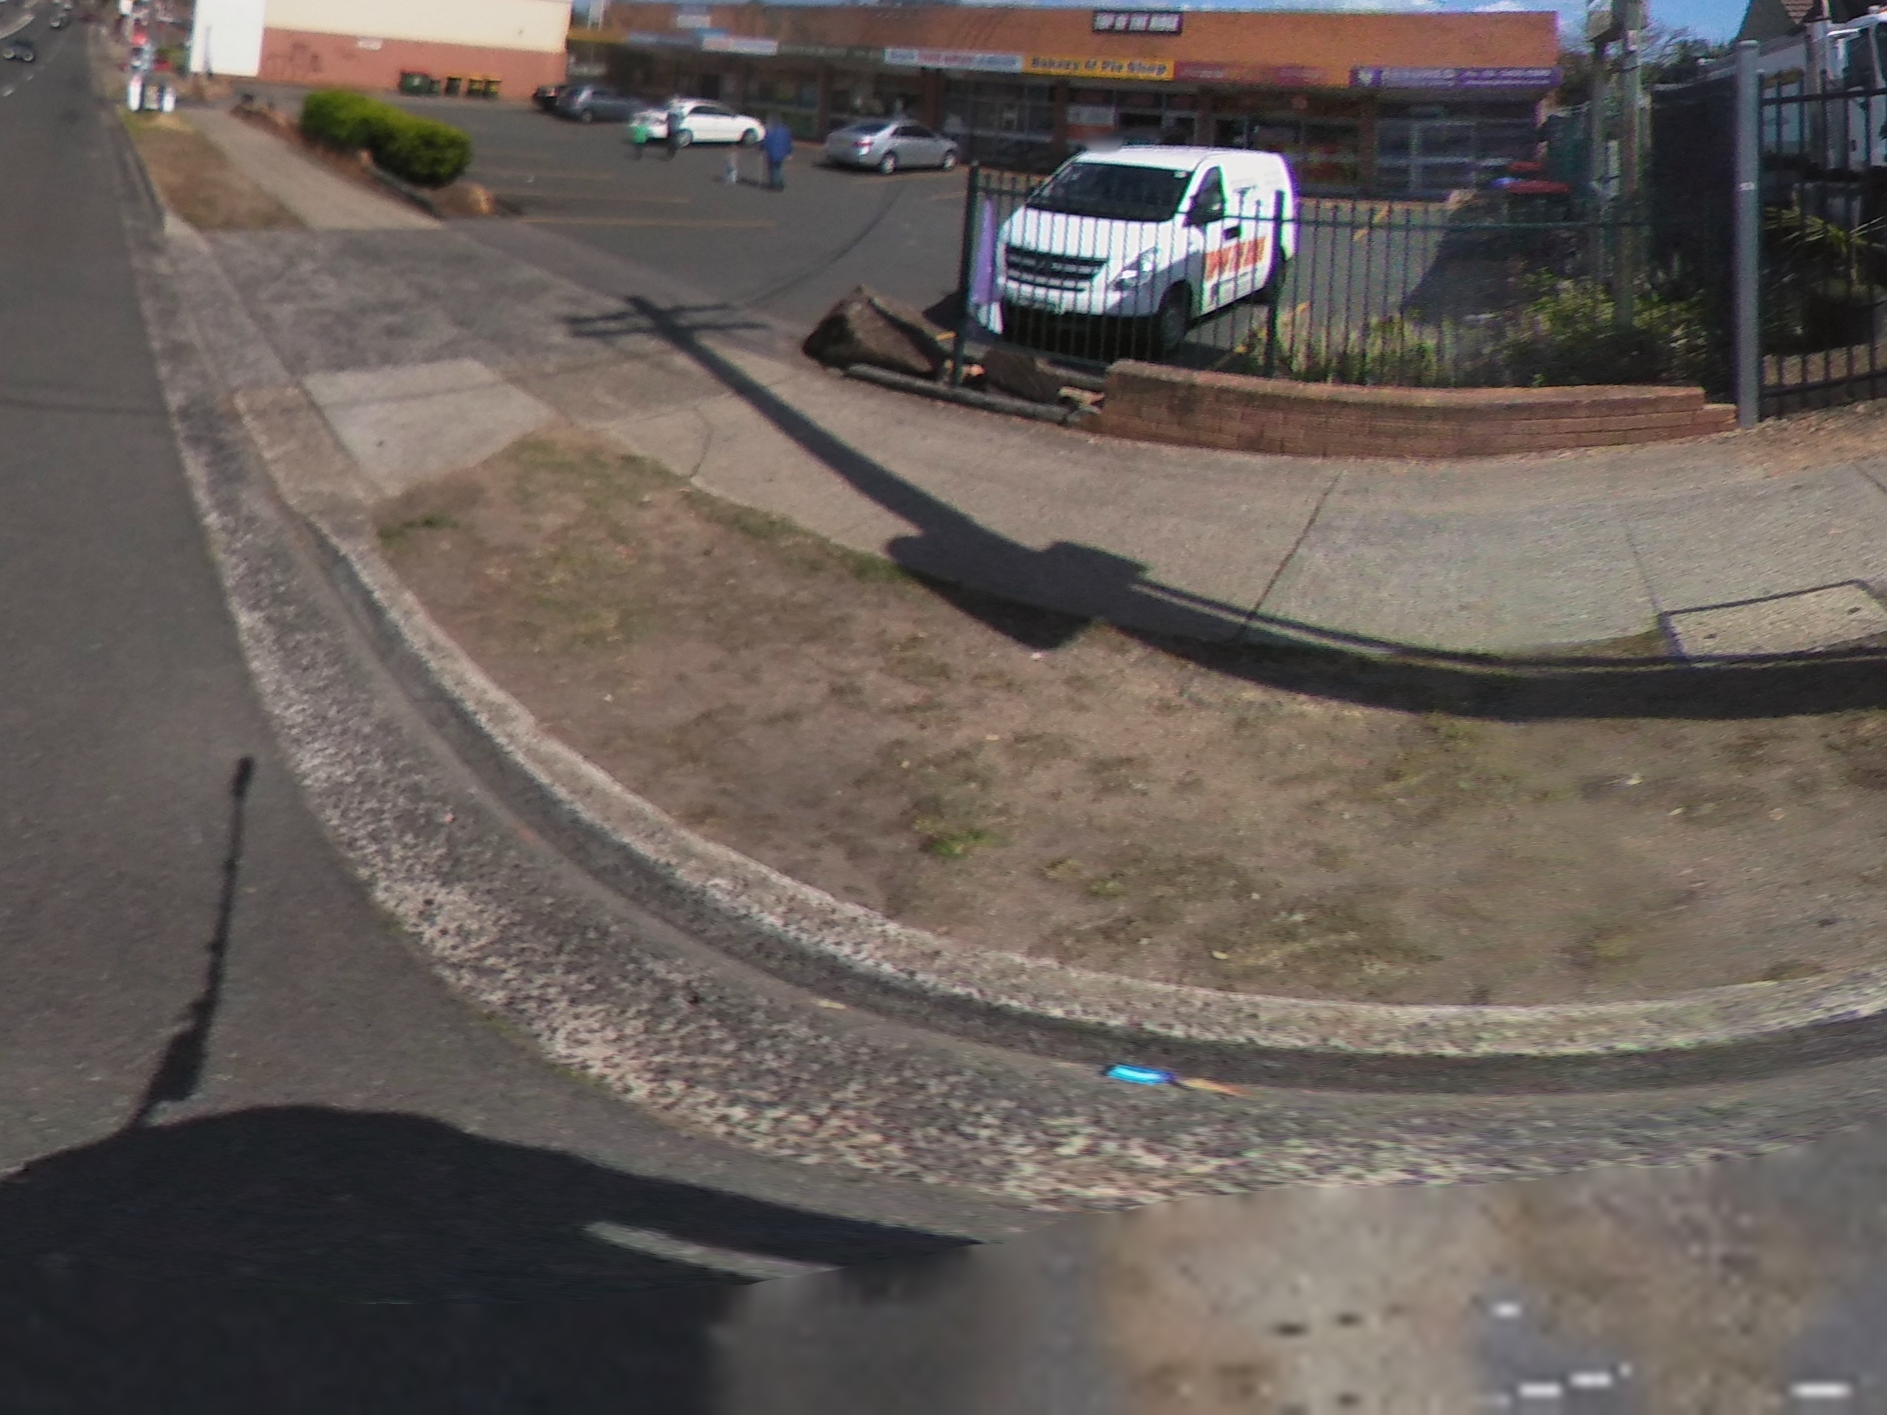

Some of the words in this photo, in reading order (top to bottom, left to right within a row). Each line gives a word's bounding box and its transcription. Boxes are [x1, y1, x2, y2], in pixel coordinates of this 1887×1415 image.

[1031, 56, 1079, 71] Bakery
[1084, 58, 1097, 70] &
[1101, 59, 1123, 73] Pie
[1127, 60, 1167, 76] Shop
